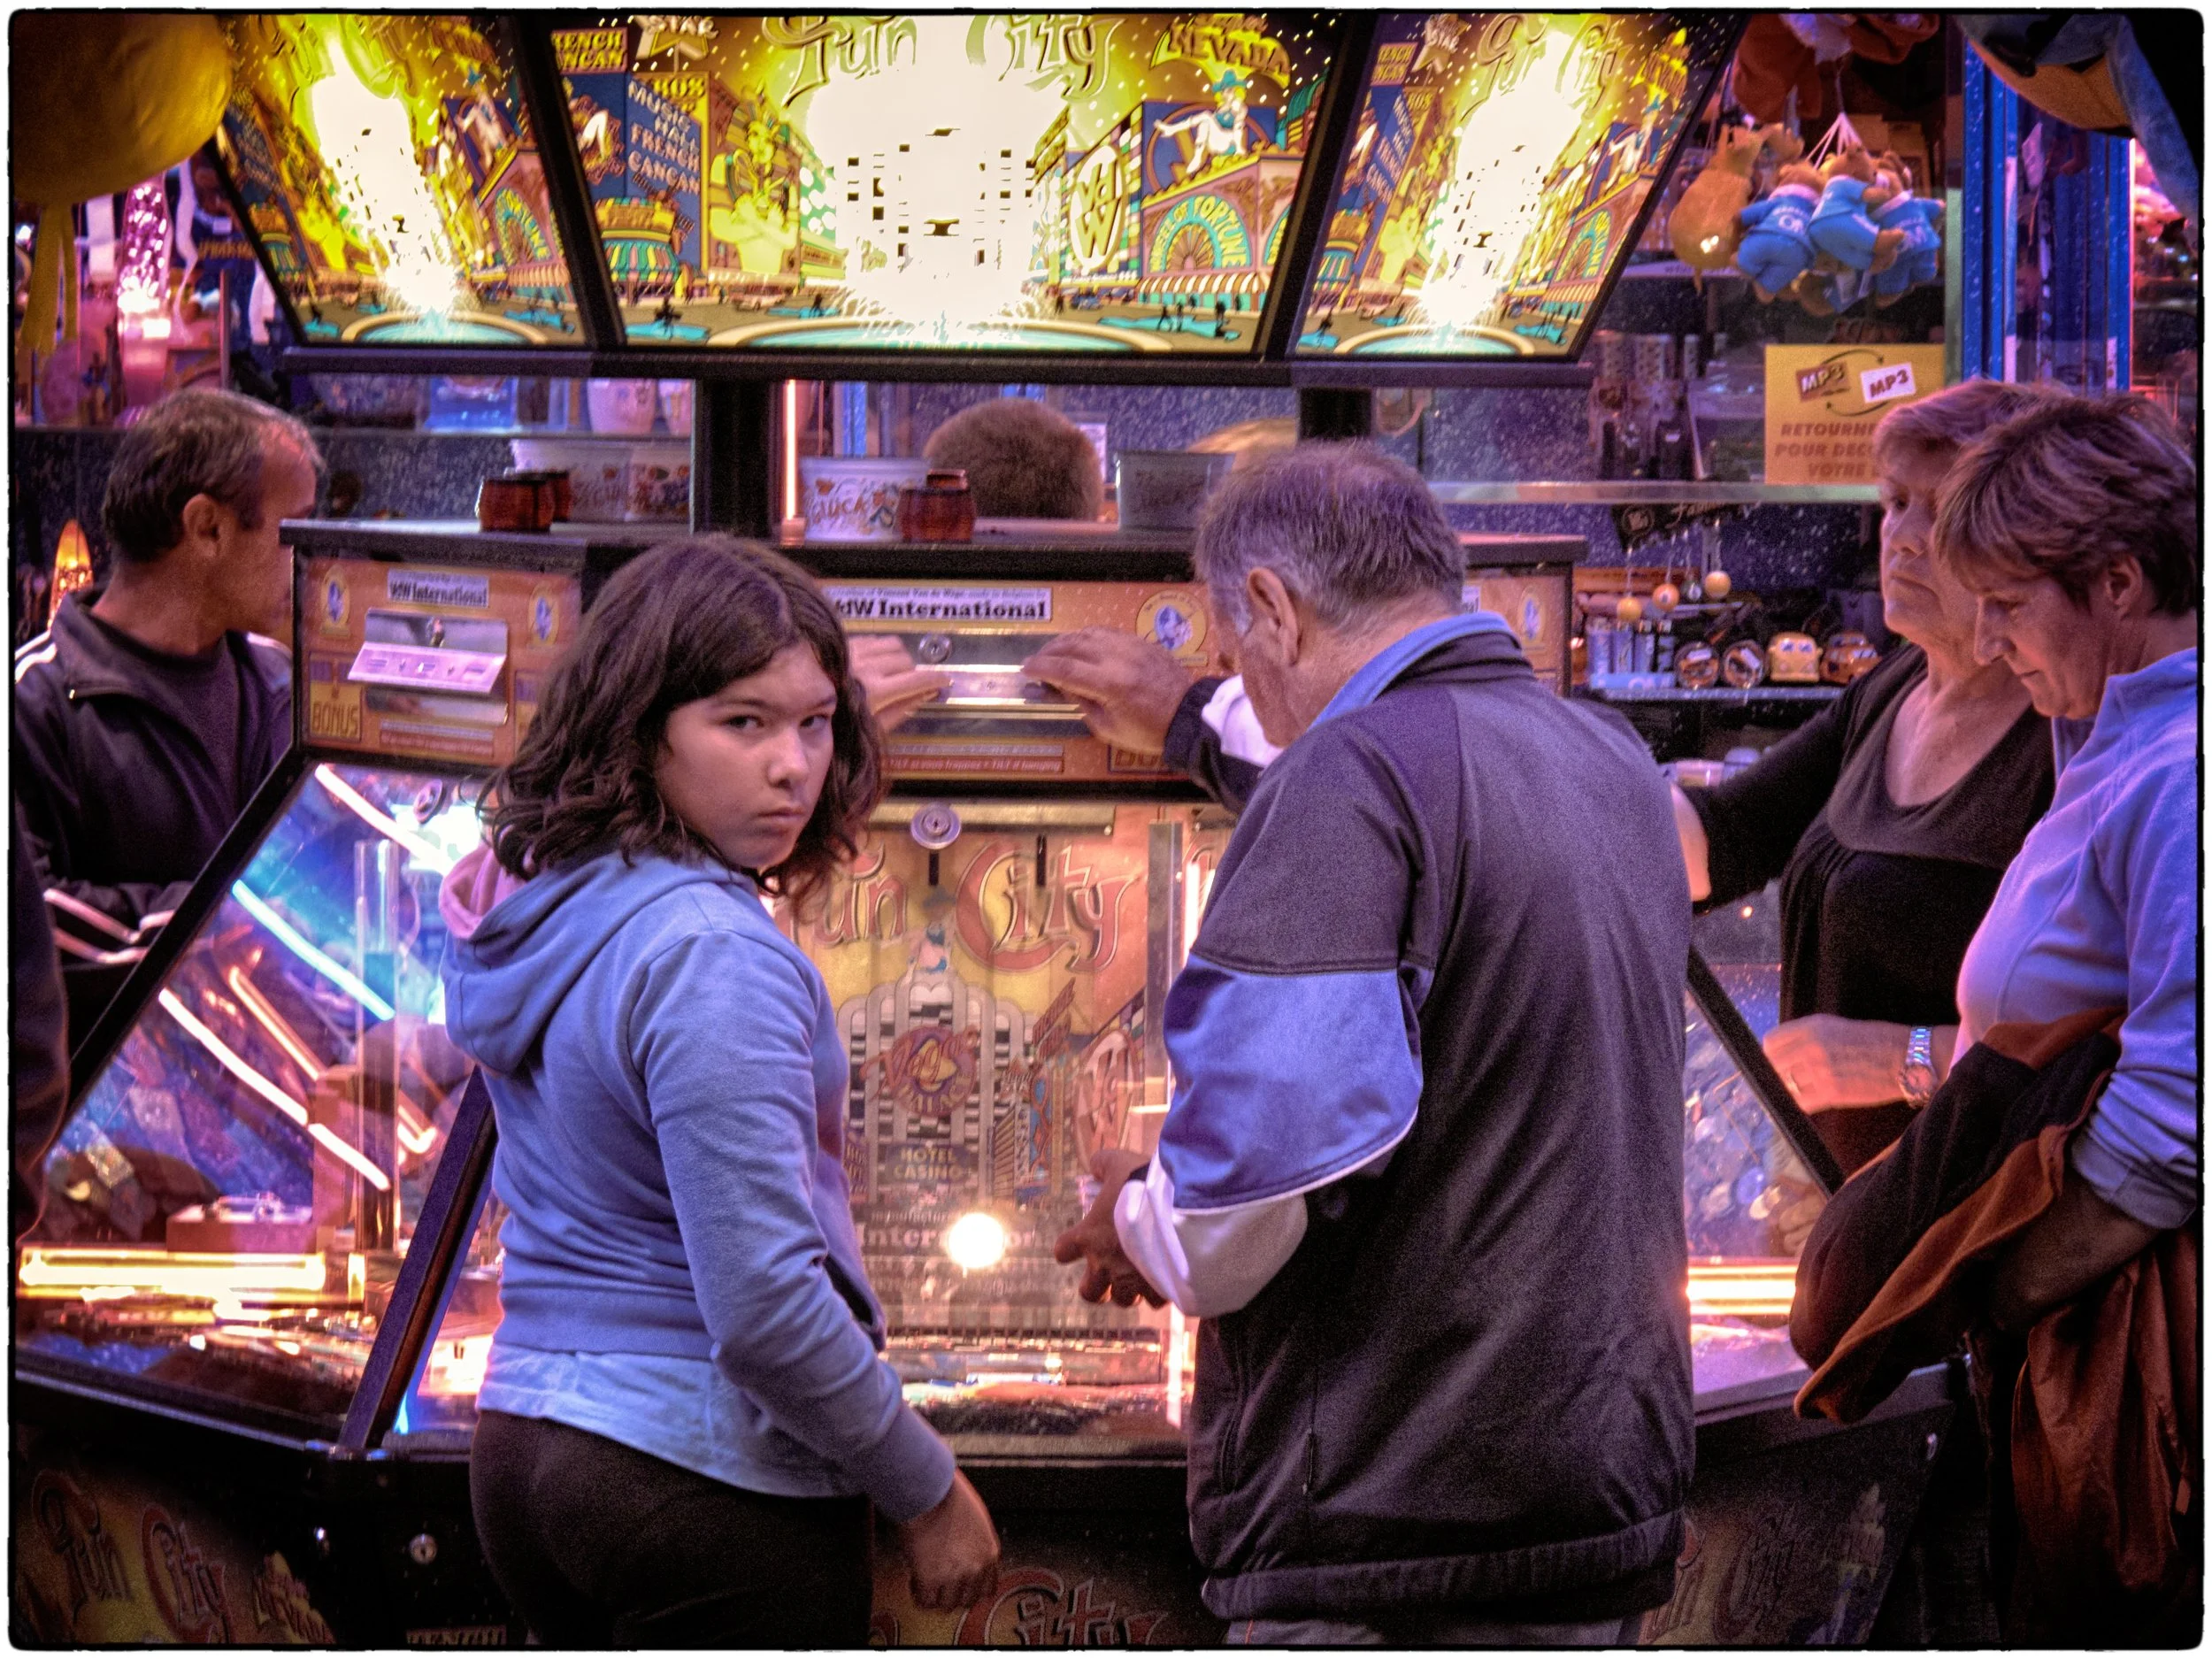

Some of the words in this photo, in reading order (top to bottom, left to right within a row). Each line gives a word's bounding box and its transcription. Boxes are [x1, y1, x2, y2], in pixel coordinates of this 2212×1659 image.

[557, 50, 624, 71] NCAN
[1167, 24, 1291, 77] NEVADA
[627, 81, 691, 134] MUSIC
[631, 122, 701, 173] FRENCH
[627, 150, 701, 196] CANCAN
[1193, 195, 1248, 269] FORTUNE
[1801, 364, 1846, 394] MP3
[1869, 369, 1909, 398] MP3
[1774, 442, 1826, 457] POUR
[1808, 462, 1866, 477] VOTRE
[879, 598, 1046, 618] International
[955, 836, 1141, 973] City
[894, 1164, 966, 1181] CASINO
[901, 1148, 957, 1163] HOTEL
